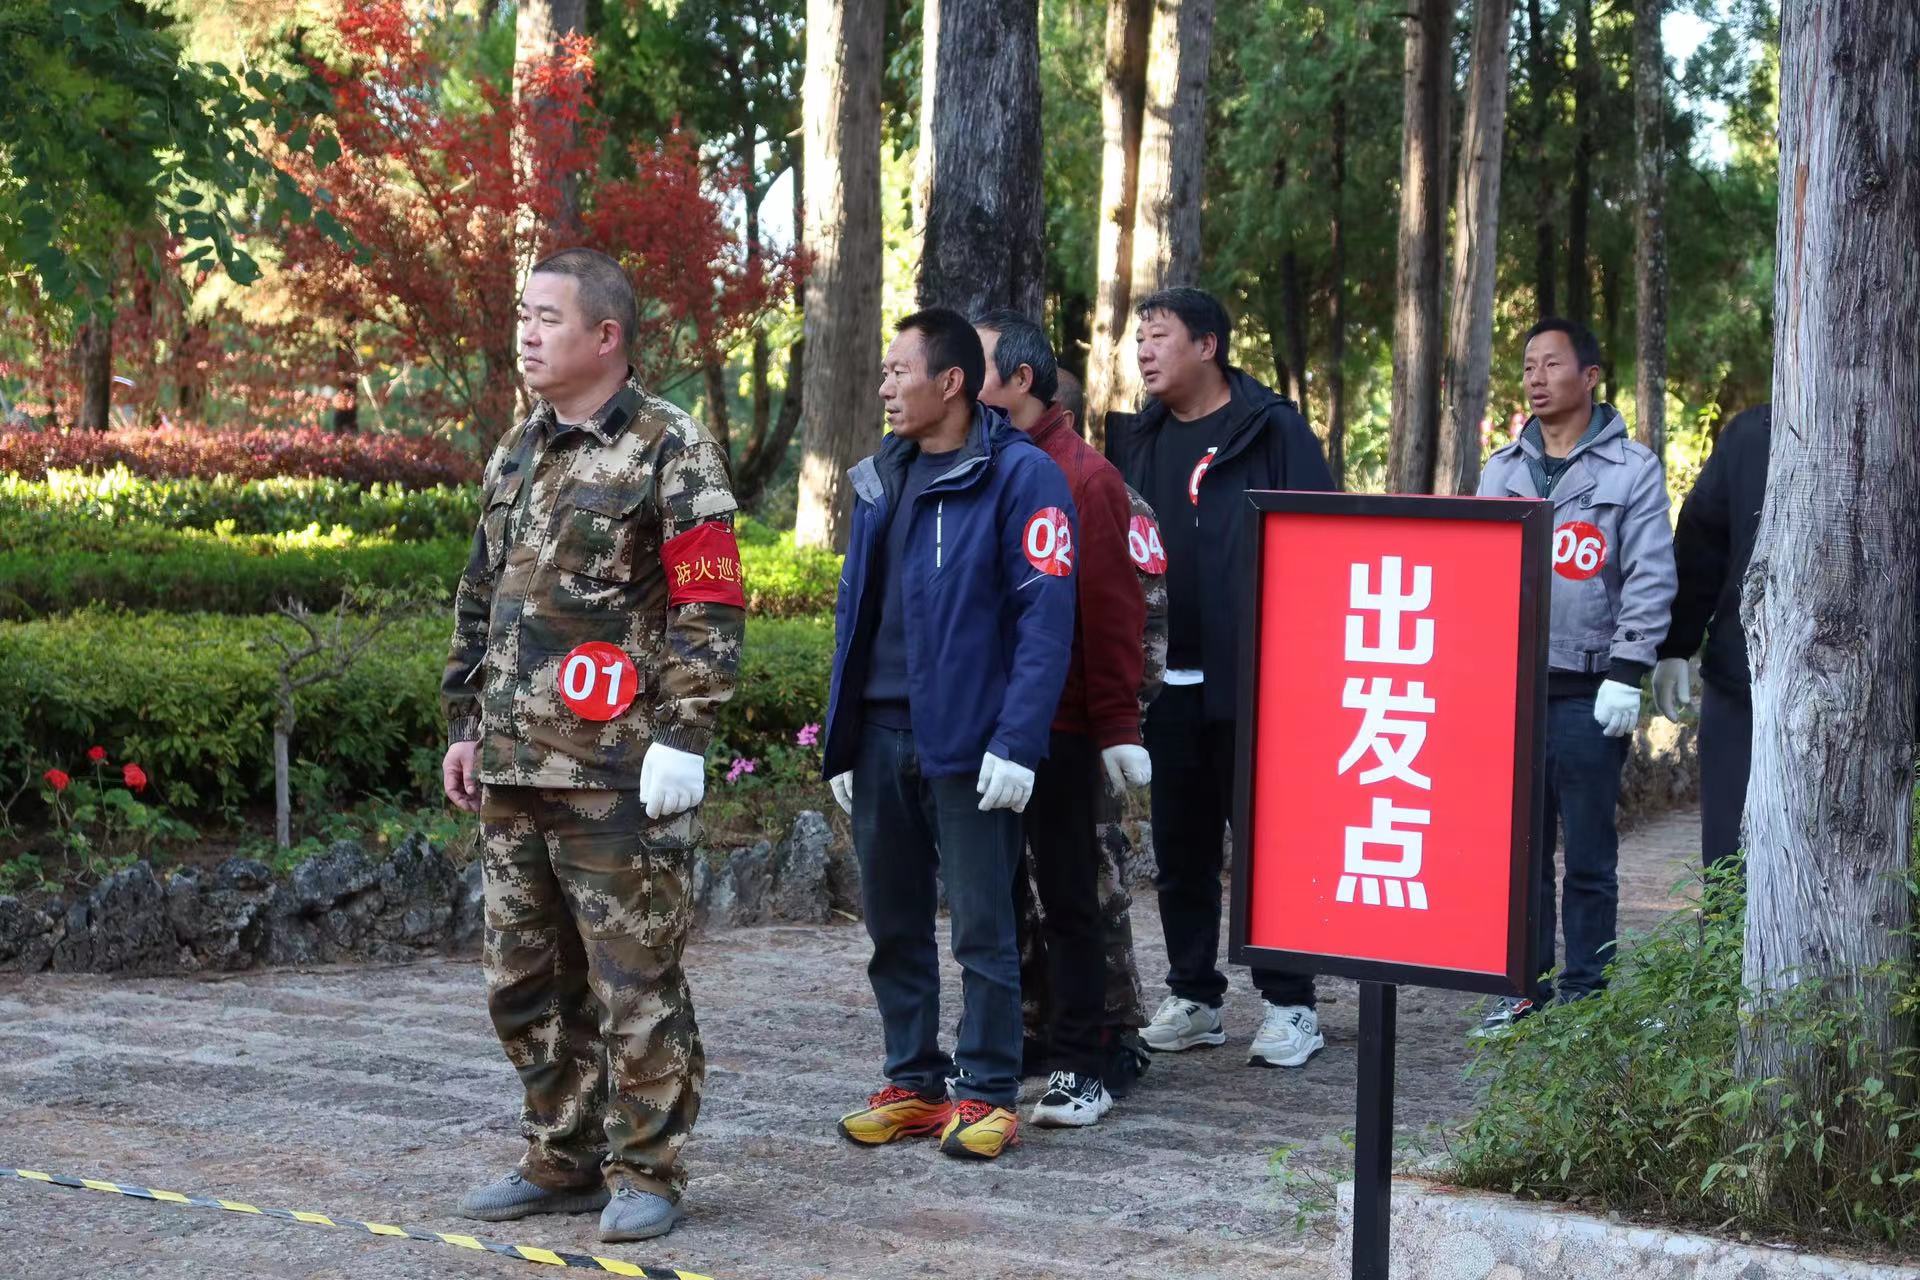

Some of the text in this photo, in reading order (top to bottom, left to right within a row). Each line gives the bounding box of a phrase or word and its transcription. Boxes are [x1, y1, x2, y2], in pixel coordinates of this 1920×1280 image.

[1028, 517, 1071, 567] 02
[1128, 526, 1165, 564] 04
[1552, 529, 1601, 571] 06
[563, 654, 623, 706] 01
[1335, 555, 1436, 910] 出发点
